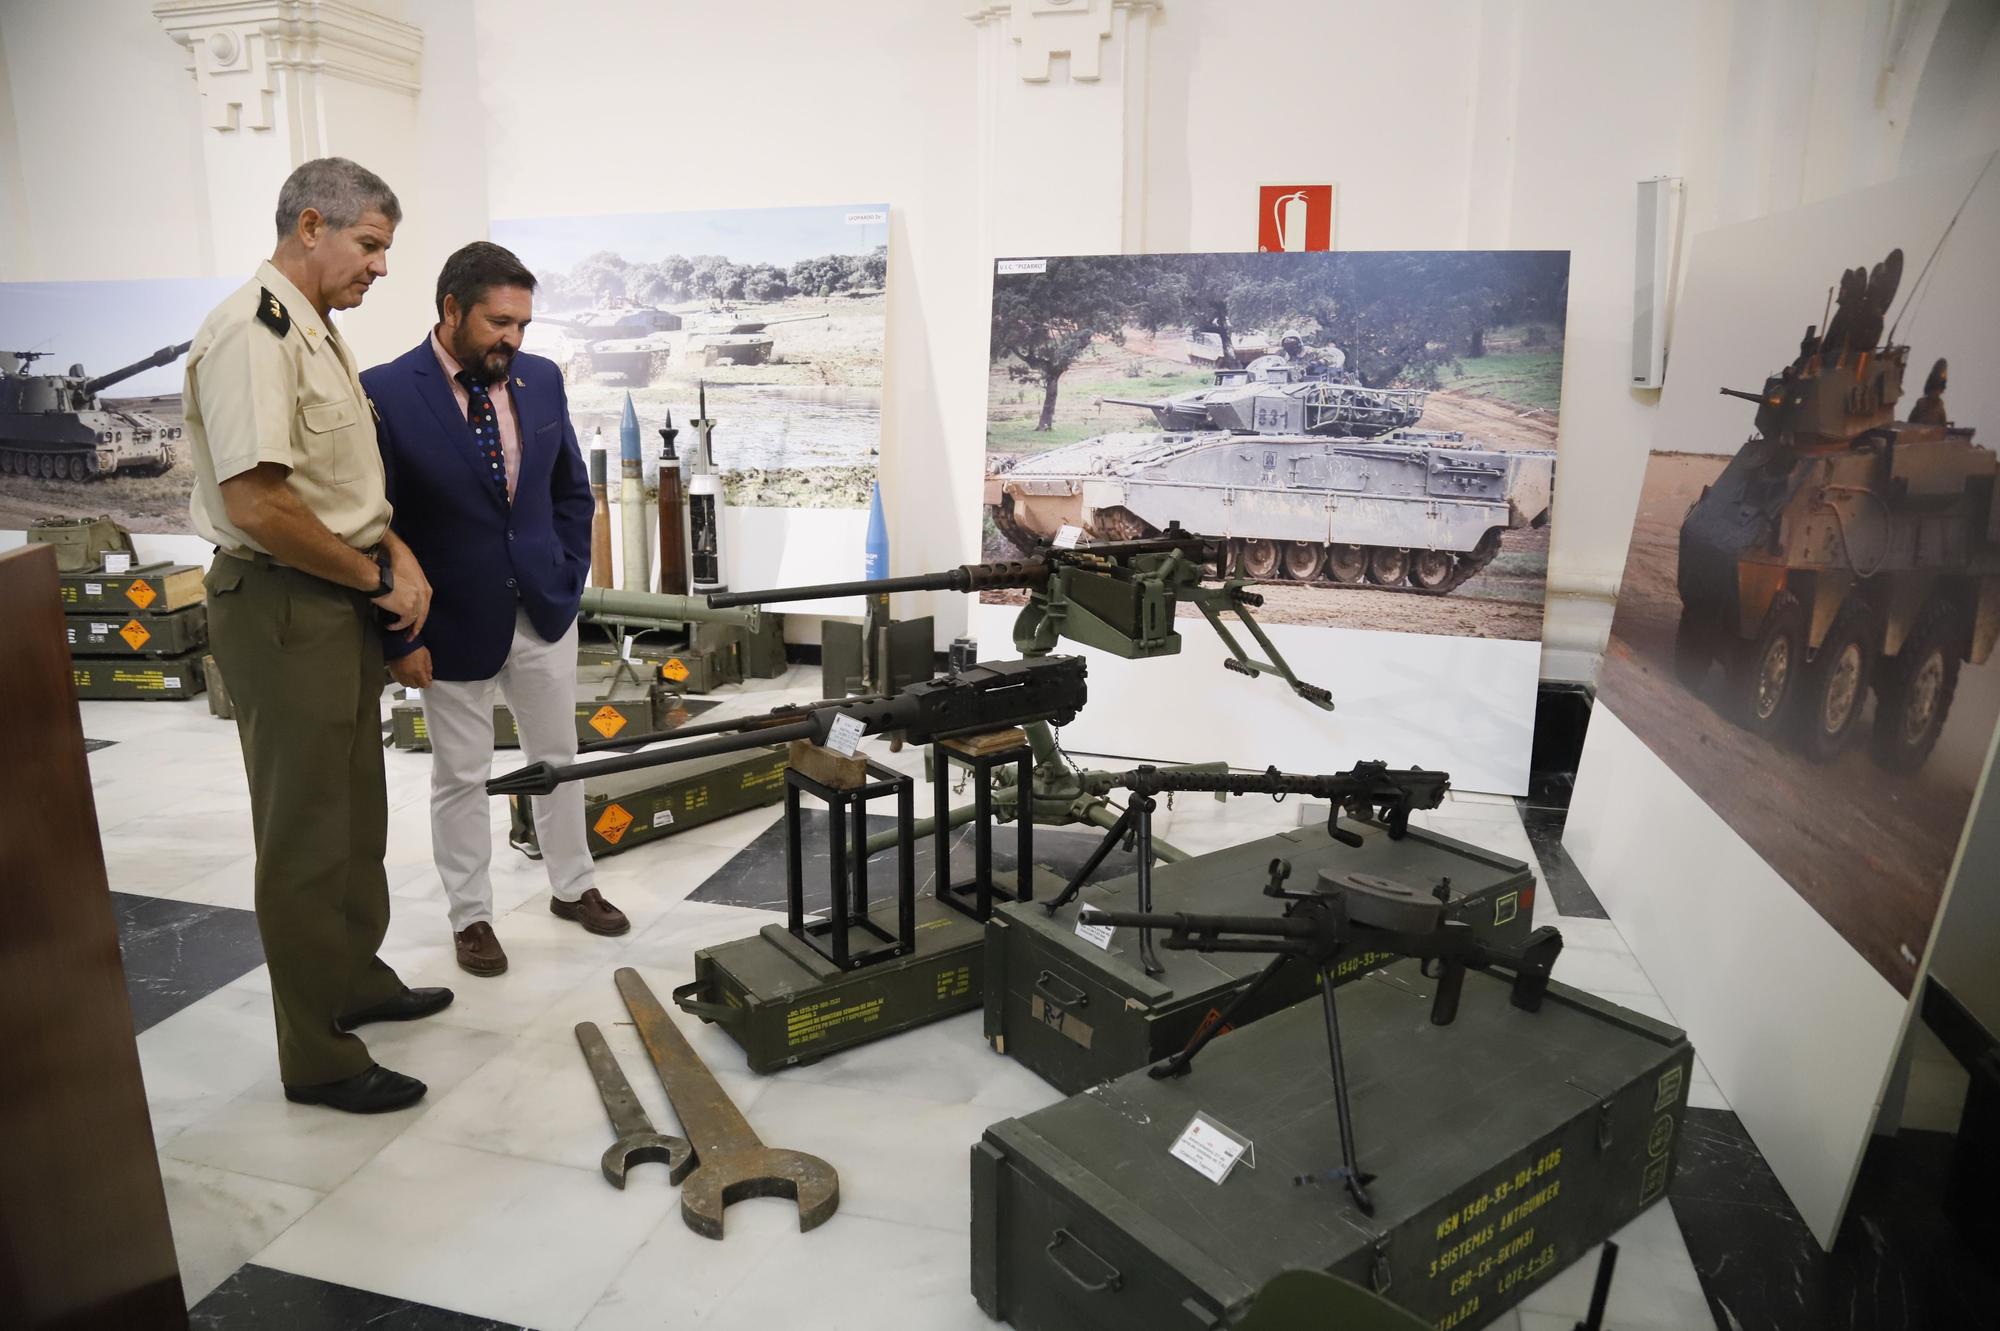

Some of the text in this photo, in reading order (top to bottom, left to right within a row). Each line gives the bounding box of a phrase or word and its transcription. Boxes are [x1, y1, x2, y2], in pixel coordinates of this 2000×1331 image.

[1337, 951, 1395, 977] 1340-33-10
[1436, 1148, 1563, 1241] NSN 1340-33-104-8126
[1429, 1180, 1561, 1279] 3 SISTEMAS ANTIBUNKER
[1498, 1264, 1526, 1295] LOTE
[1436, 1296, 1481, 1331] TALAZA
